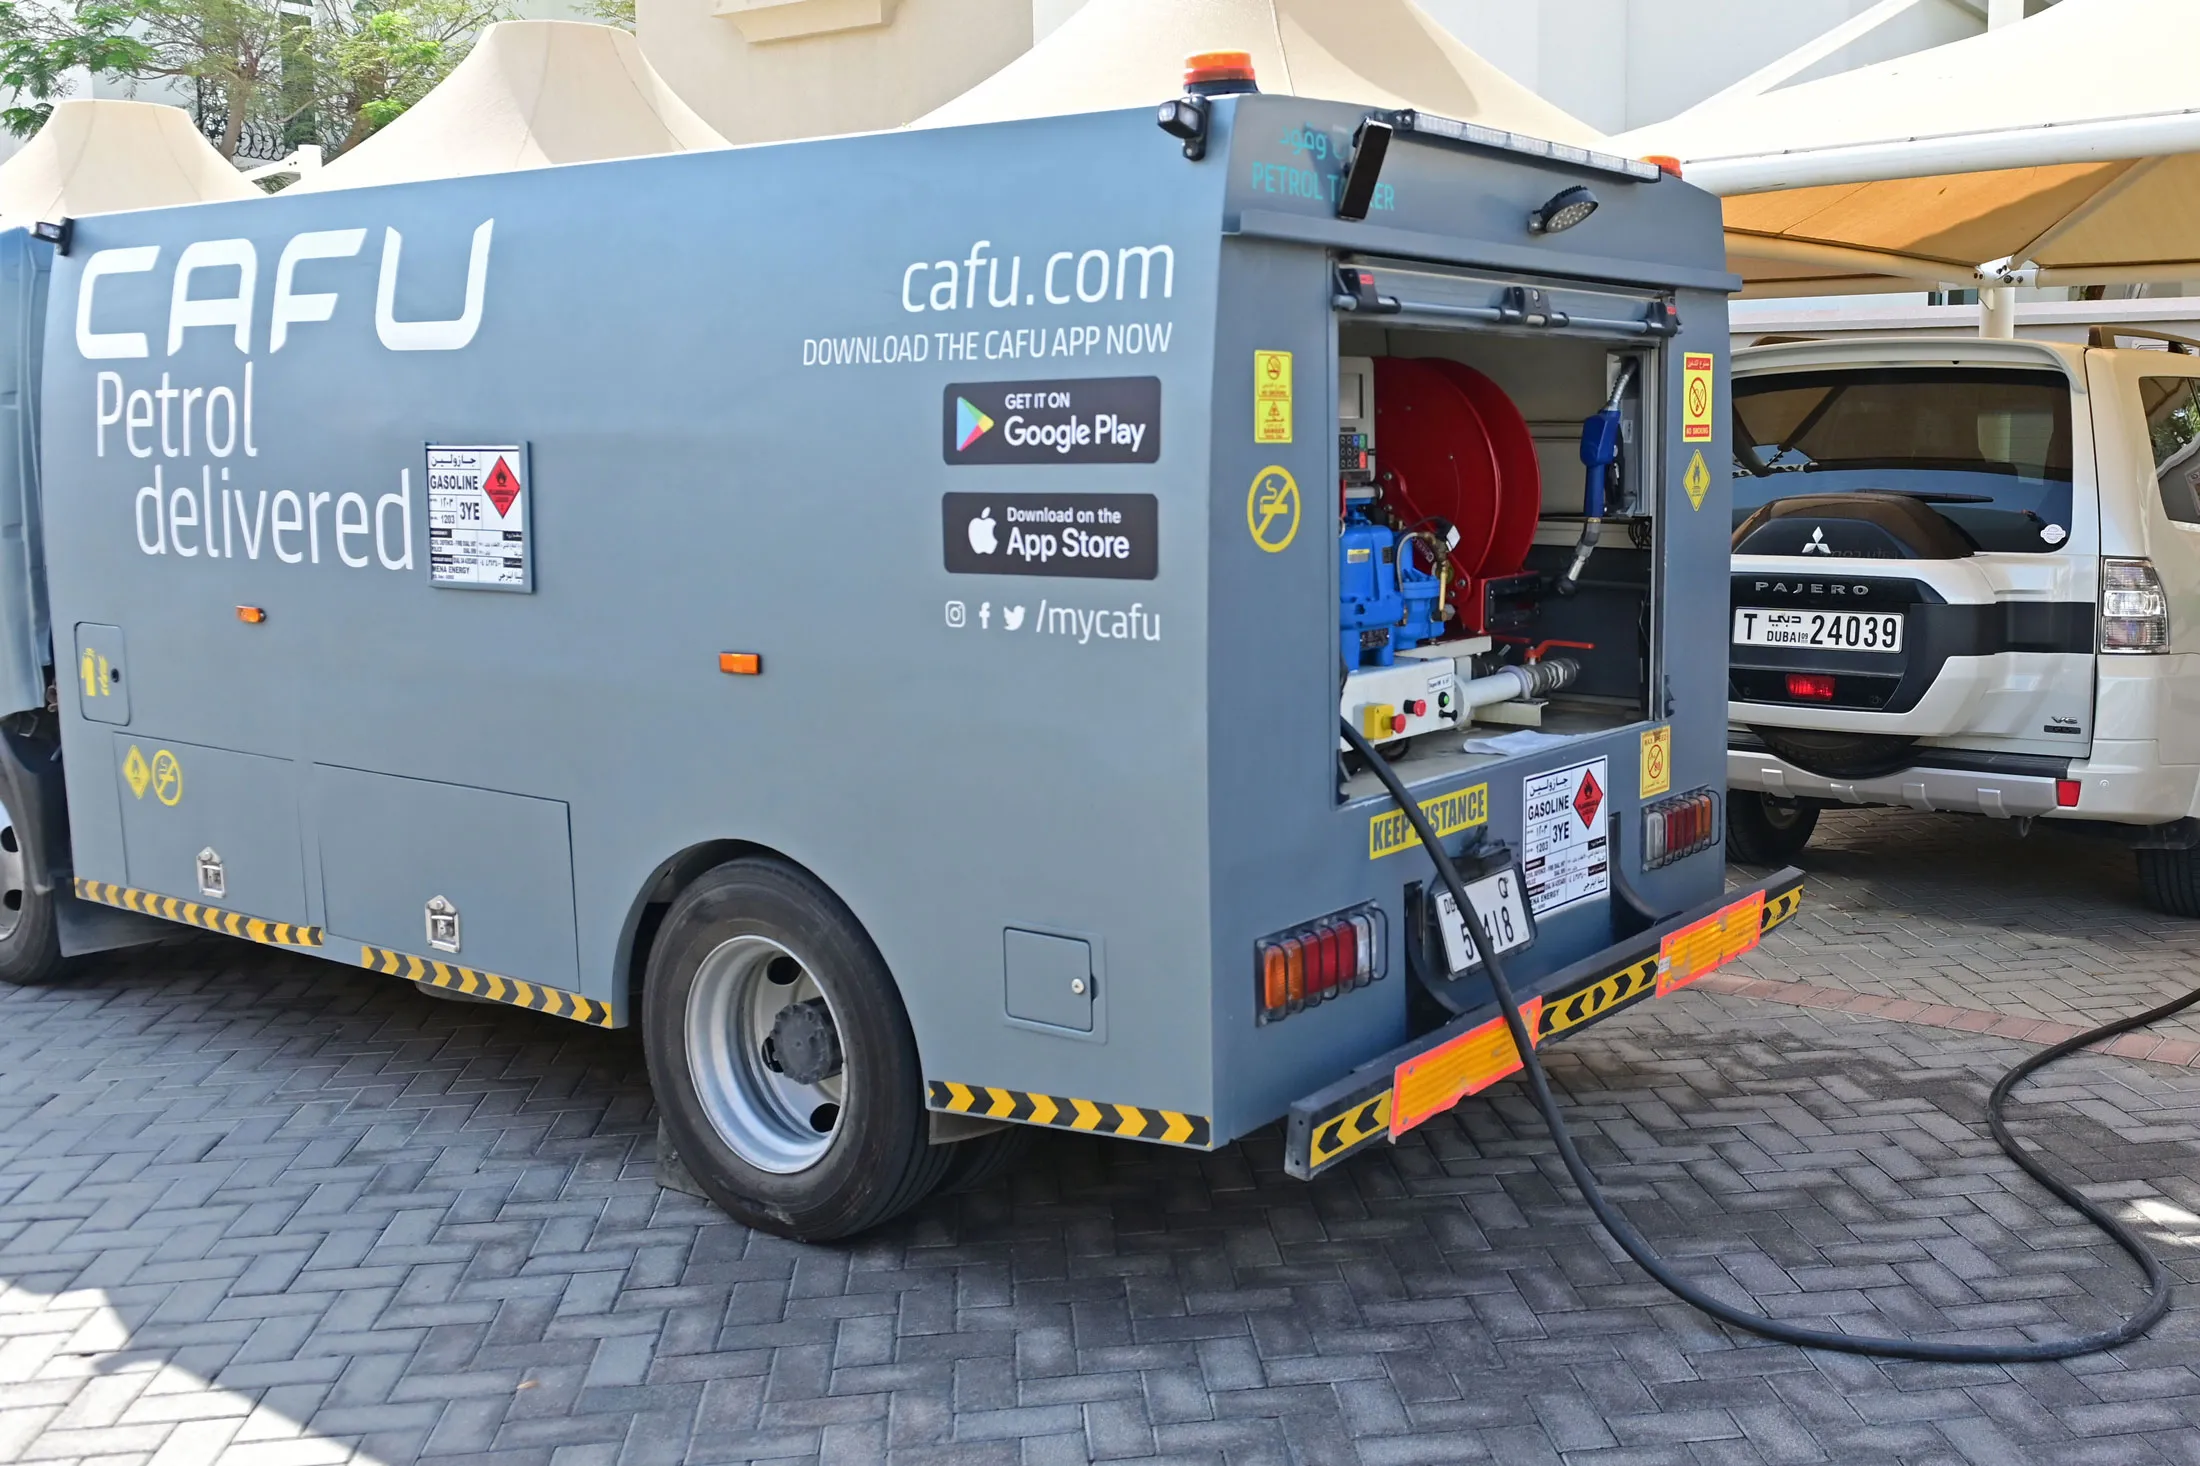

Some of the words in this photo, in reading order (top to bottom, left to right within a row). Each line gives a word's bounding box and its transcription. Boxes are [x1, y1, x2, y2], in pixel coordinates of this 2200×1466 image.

[1252, 161, 1323, 200] PETROL
[76, 218, 494, 359] CAFU
[901, 241, 1174, 312] cafu.com
[803, 333, 928, 365] DOWNLOAD
[935, 331, 979, 361] THE
[985, 328, 1046, 359] CAFU
[1051, 325, 1101, 357] APP
[1106, 322, 1172, 354] NOW
[96, 361, 258, 458] Petrol
[1005, 393, 1032, 410] GET
[1033, 393, 1046, 409] IT
[1048, 392, 1070, 409] ON
[1004, 415, 1089, 453] Google
[1095, 414, 1145, 452] Play
[430, 475, 478, 490] GASOLINE
[135, 465, 415, 570] delivered
[460, 502, 480, 520] 3YE
[1007, 507, 1073, 523] Download
[1077, 511, 1094, 523] on
[1097, 508, 1121, 524] the
[1007, 529, 1056, 561] App
[1062, 528, 1130, 559] Store
[1755, 581, 1869, 596] PAJERO
[1036, 600, 1161, 644] /mycafu
[1743, 613, 1757, 641] T
[1766, 630, 1800, 643] DUBAI
[1810, 615, 1897, 648] 24039
[1373, 815, 1411, 852] KEEP
[1415, 789, 1484, 838] ISTANCE
[1528, 795, 1569, 820] GASOLINE
[1553, 821, 1569, 843] 3YE
[1461, 906, 1514, 961] 5418
